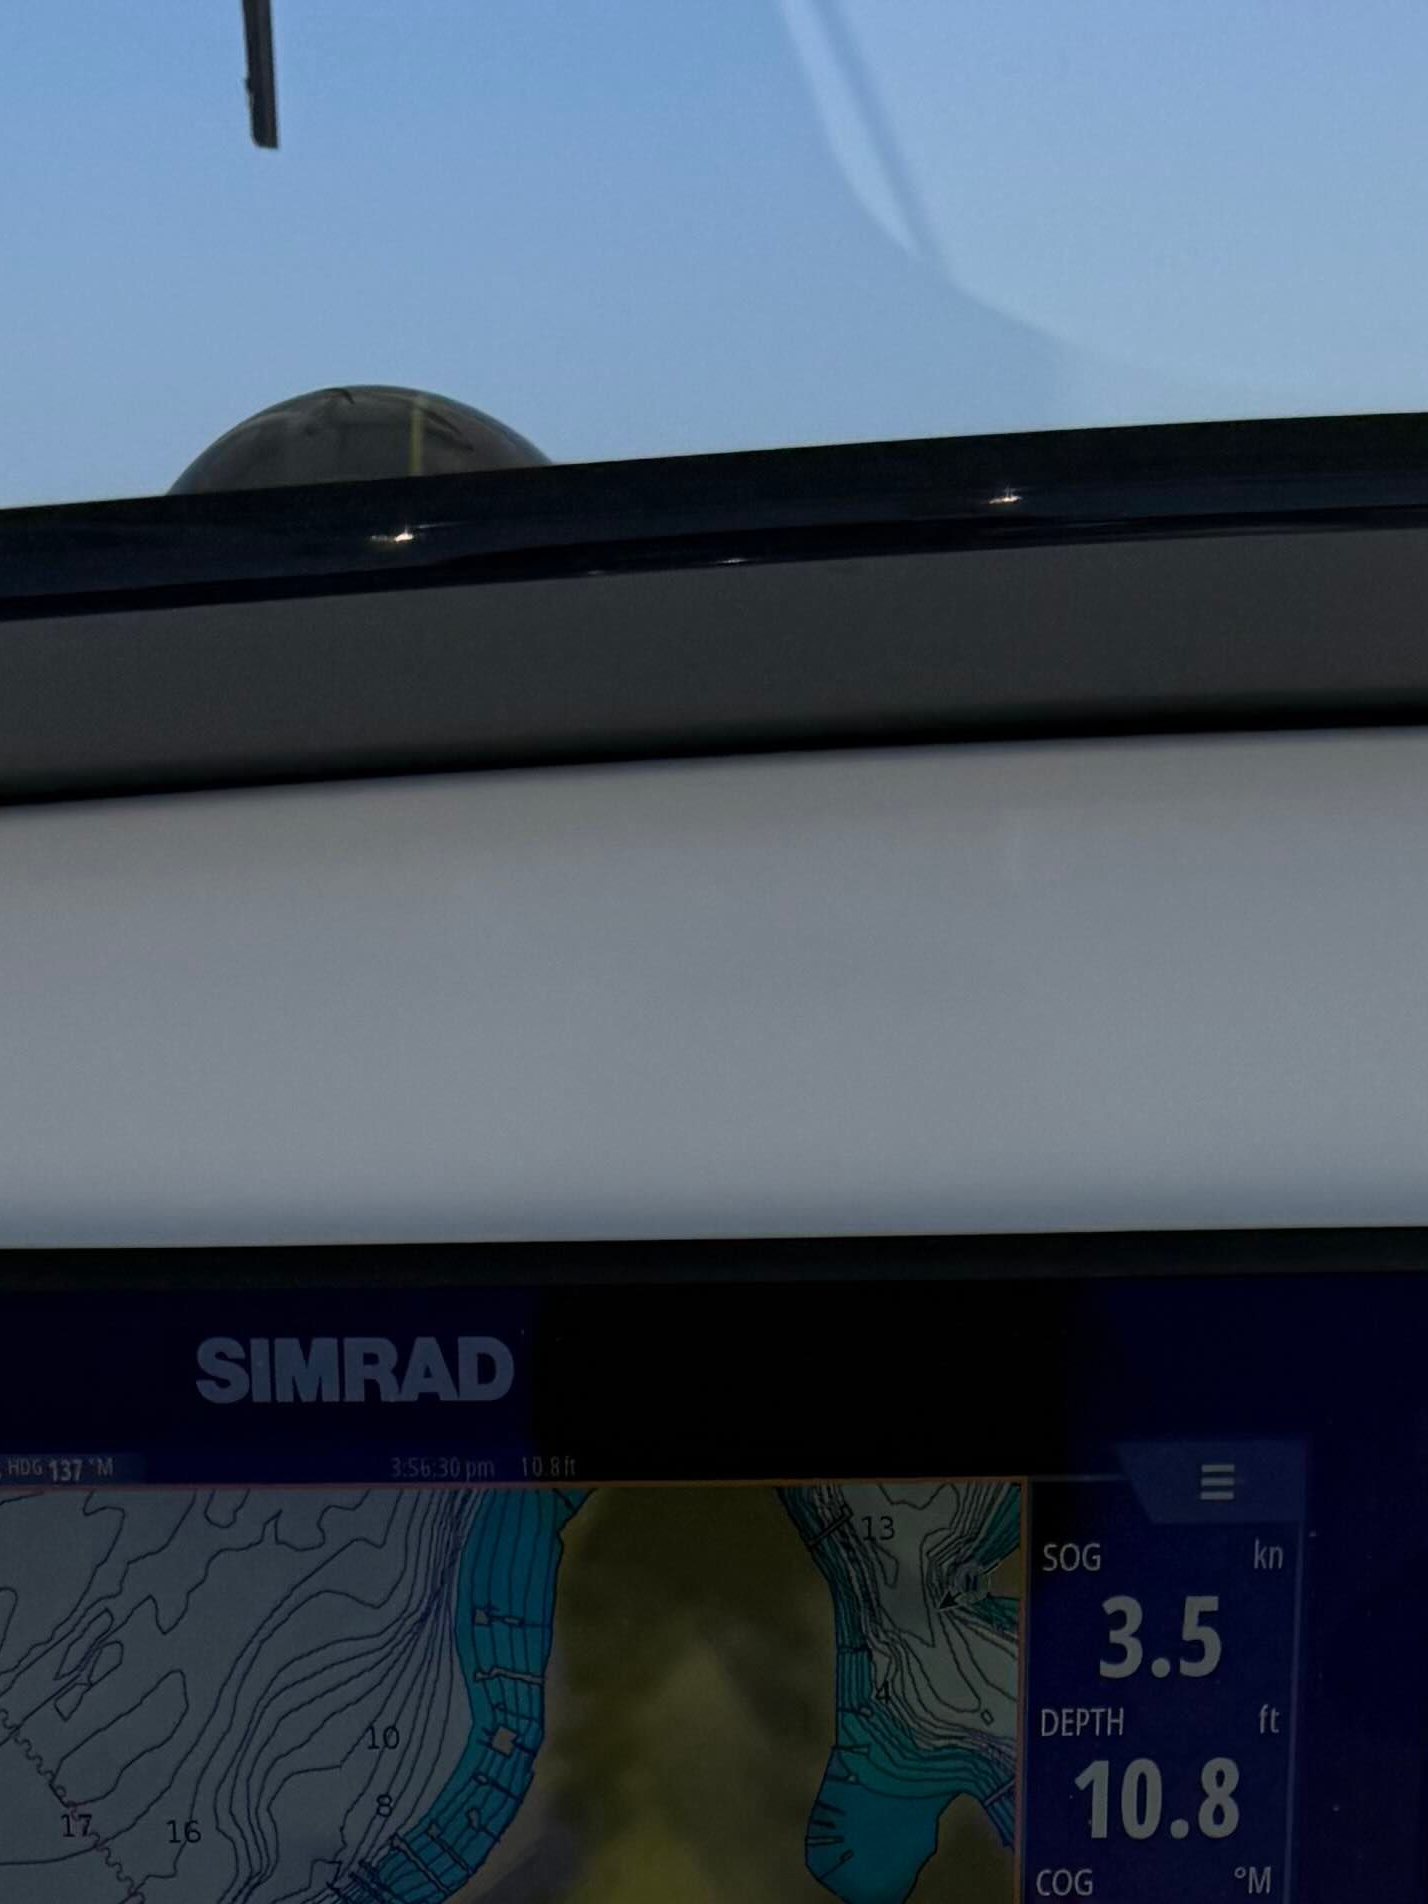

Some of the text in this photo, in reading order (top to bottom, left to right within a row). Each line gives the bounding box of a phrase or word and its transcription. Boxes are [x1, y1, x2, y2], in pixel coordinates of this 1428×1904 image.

[195, 1335, 515, 1404] SIMRAD
[7, 1459, 43, 1476] HDG
[49, 1459, 83, 1482] 137
[466, 1459, 496, 1480] pm
[861, 1516, 895, 1540] 13
[1042, 1537, 1285, 1573] SOG kn
[1098, 1593, 1224, 1680] 3.5
[1039, 1704, 1282, 1738] DEPTH ft
[367, 1724, 401, 1750] 10
[375, 1794, 394, 1818] 8
[1074, 1755, 1242, 1841] 10.8
[61, 1814, 91, 1838] 17
[168, 1820, 202, 1844] 16
[1035, 1867, 1094, 1898] COG
